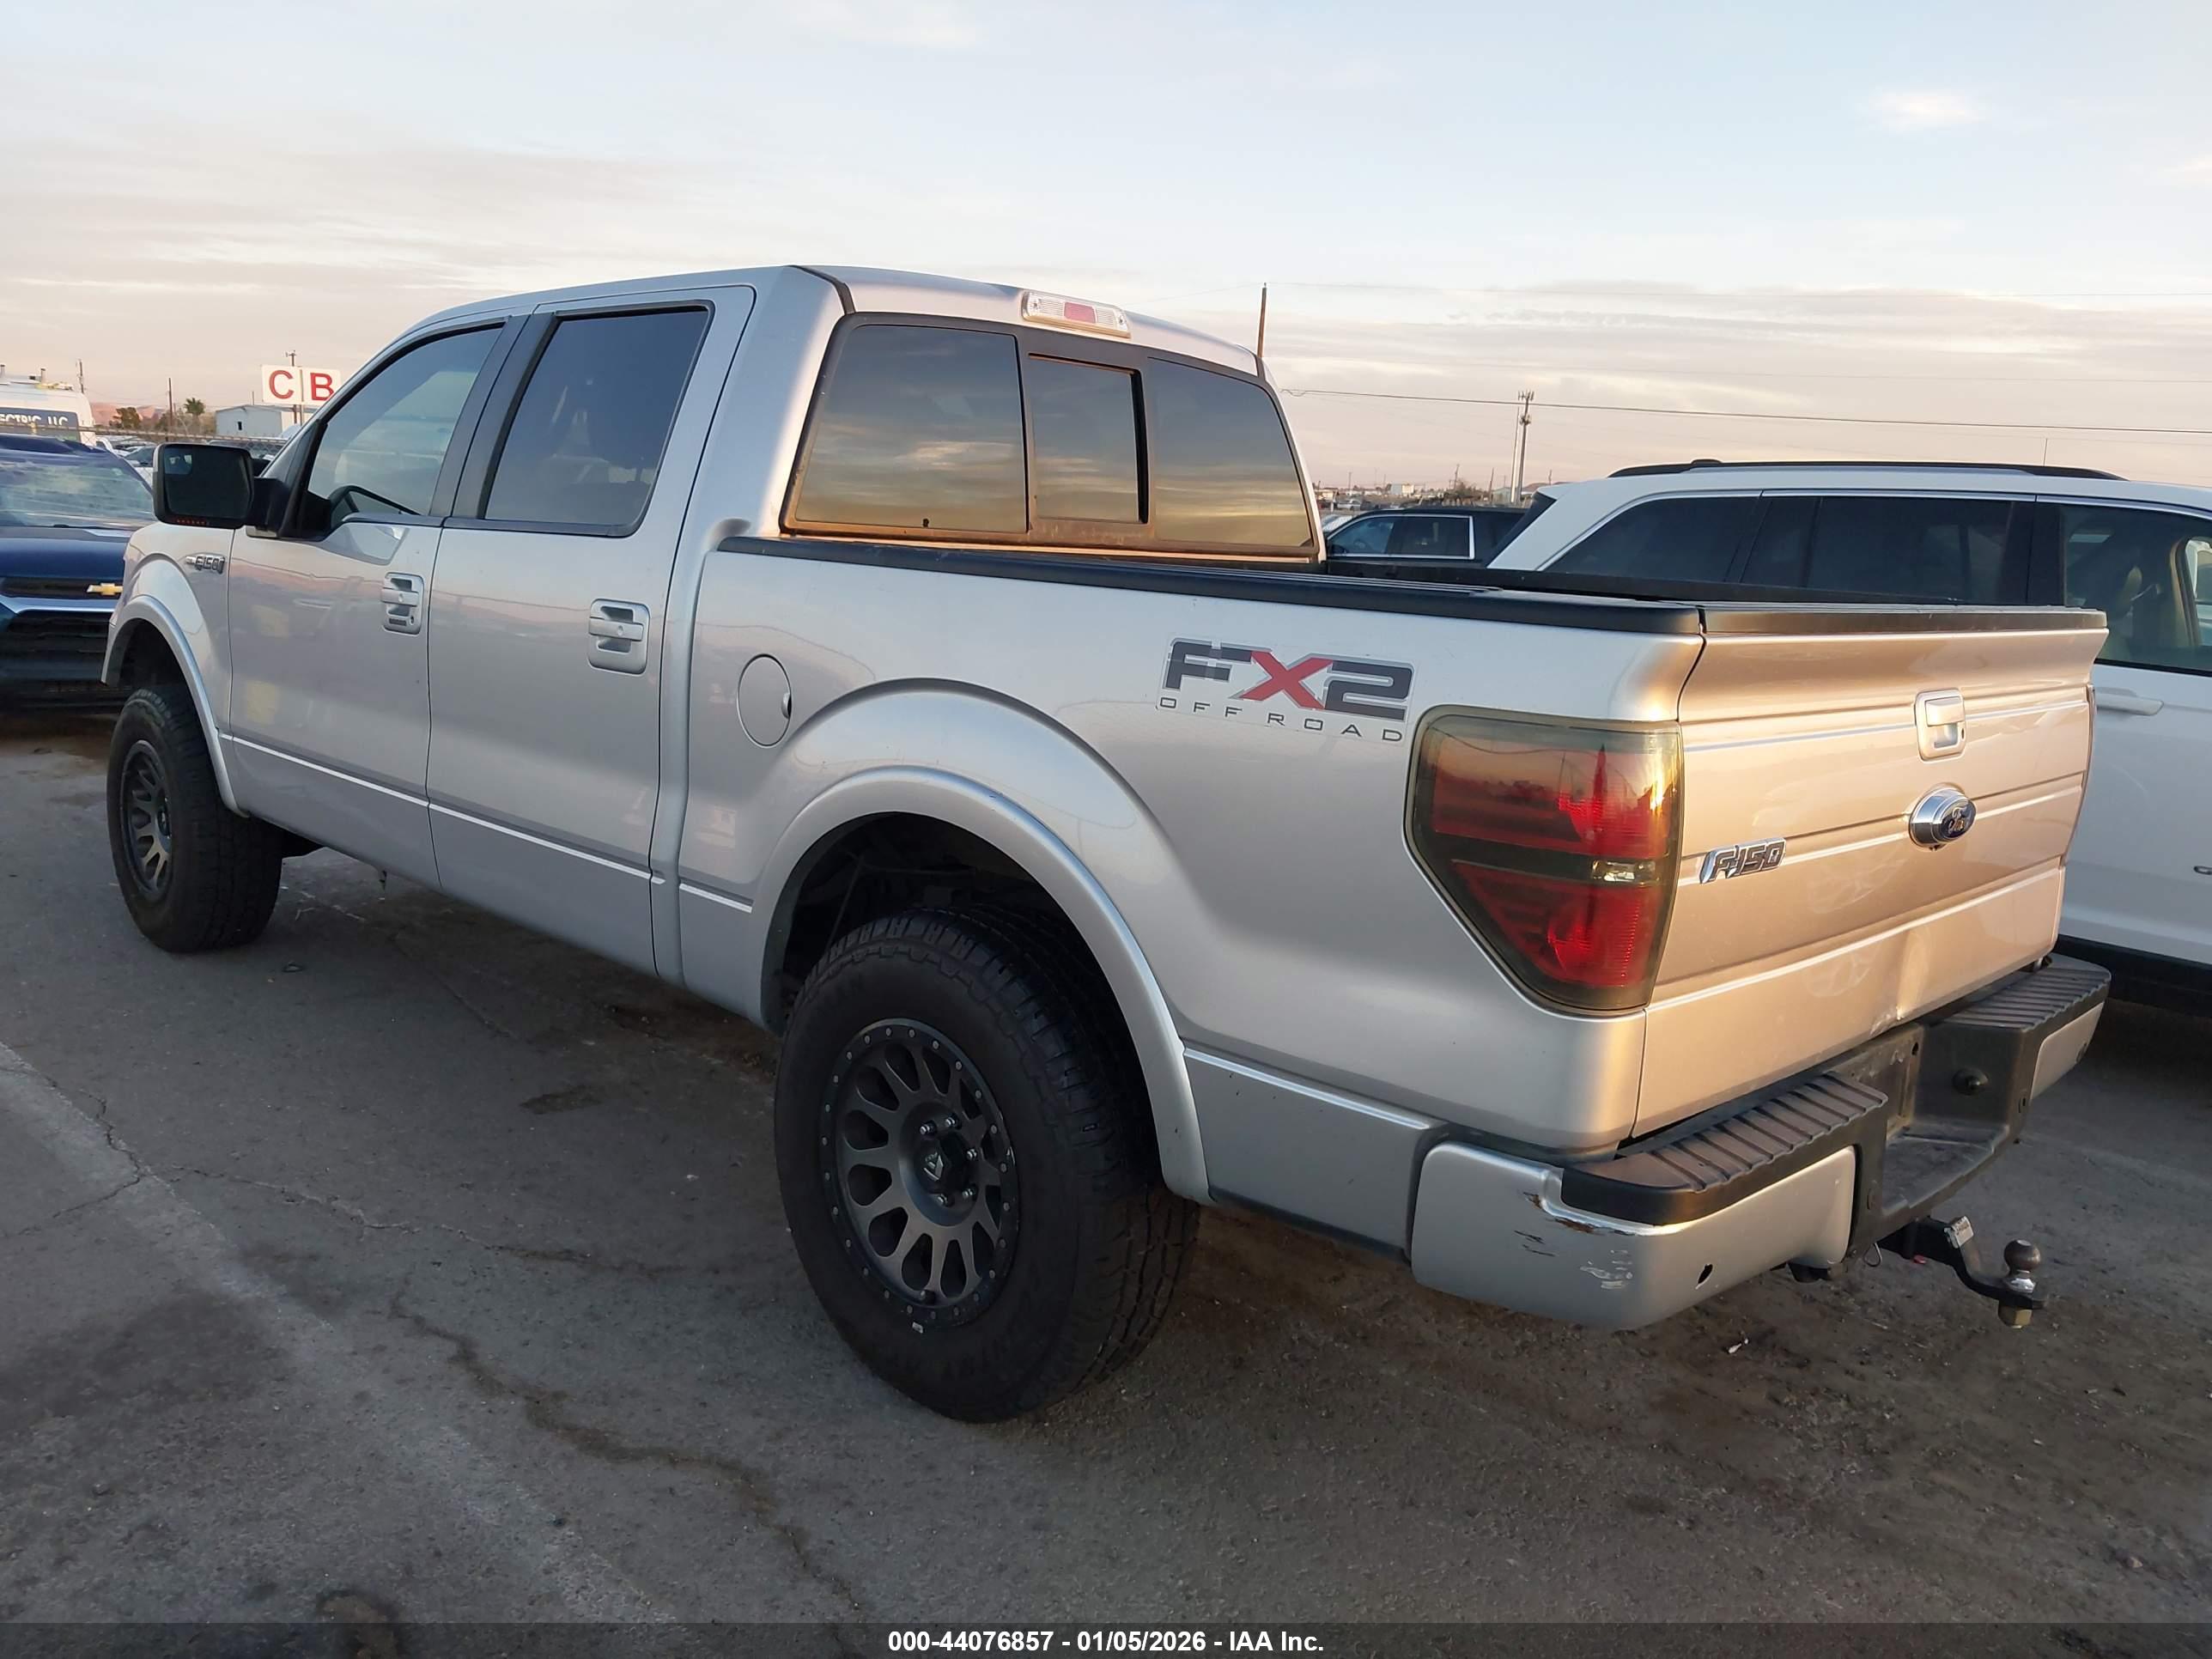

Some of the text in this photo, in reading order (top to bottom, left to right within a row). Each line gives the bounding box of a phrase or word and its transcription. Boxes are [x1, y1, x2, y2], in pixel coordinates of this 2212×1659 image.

[269, 369, 334, 401] C B
[1161, 637, 1415, 722] FX2
